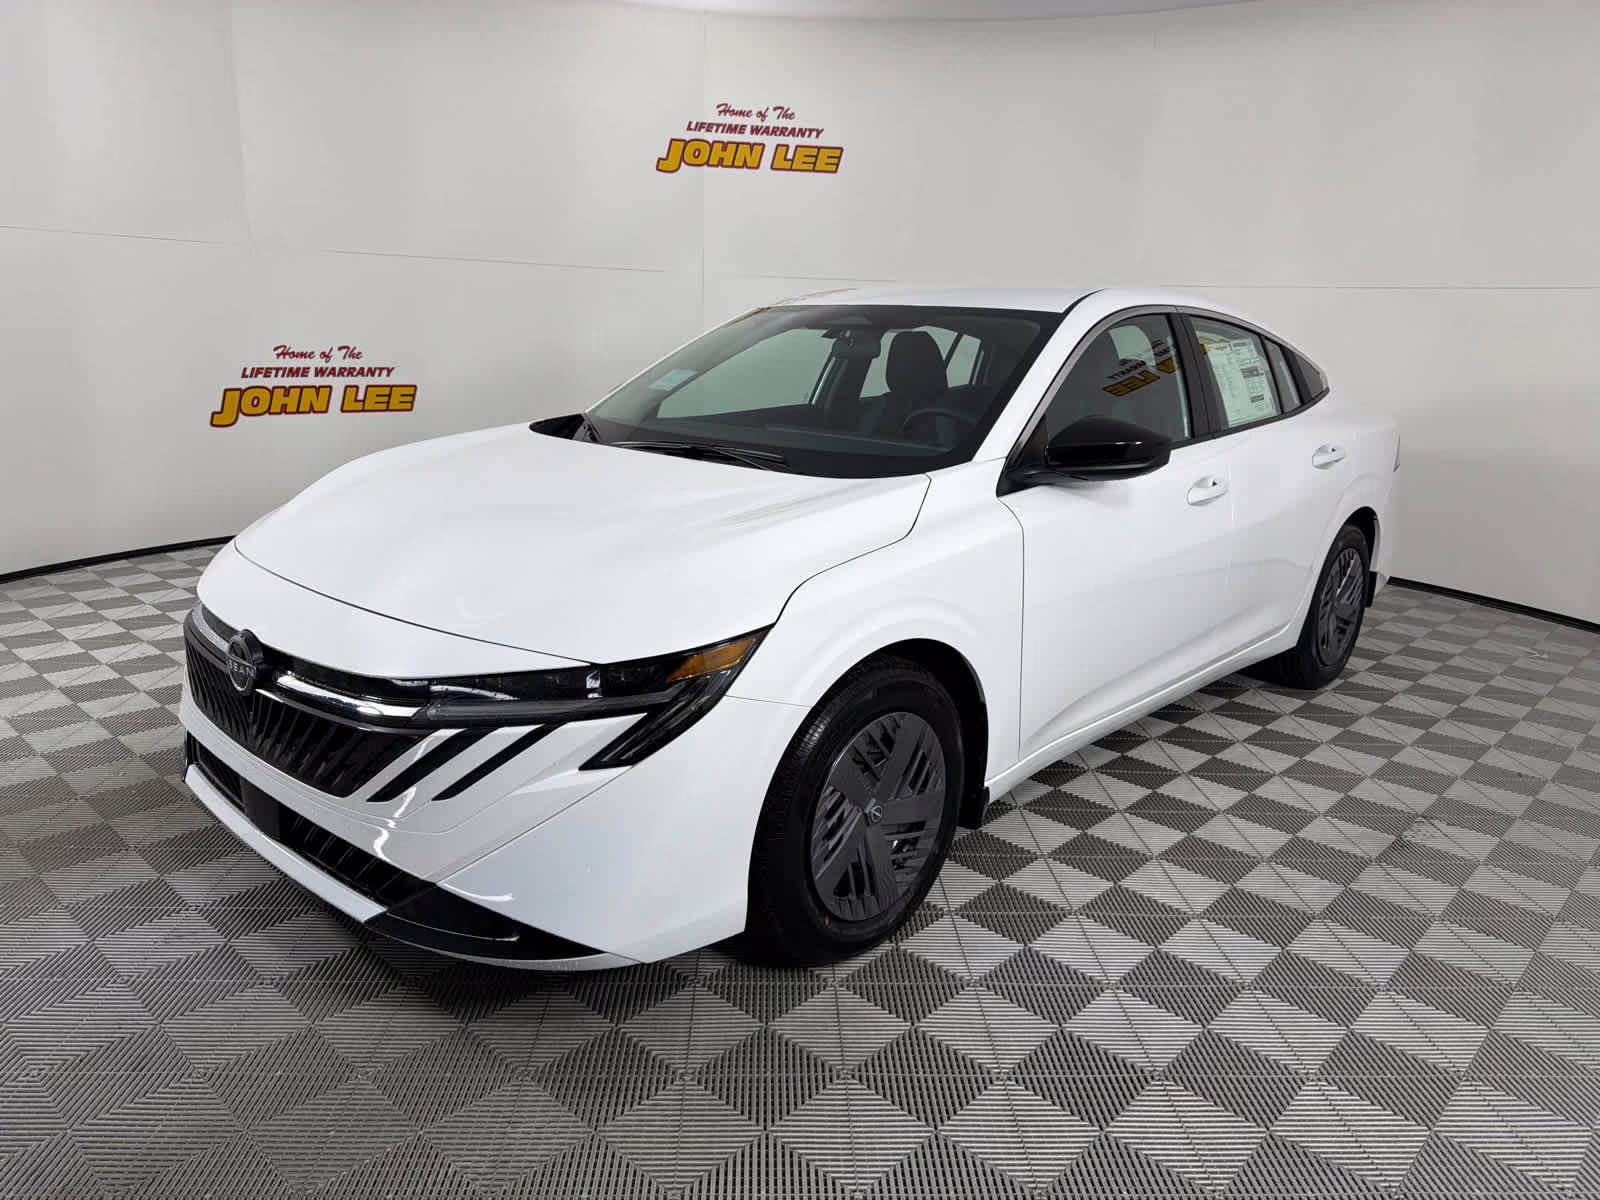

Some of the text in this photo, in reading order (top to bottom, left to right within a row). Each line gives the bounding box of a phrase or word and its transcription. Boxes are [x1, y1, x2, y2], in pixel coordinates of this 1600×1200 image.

[716, 103, 795, 122] Home of The
[686, 121, 824, 138] LIFETIME WARRANTY
[656, 138, 844, 173] JOHN LEE
[273, 345, 363, 363] Home of The
[241, 366, 395, 378] LIFETIME WARRANTY
[210, 384, 417, 428] JOHN LEE
